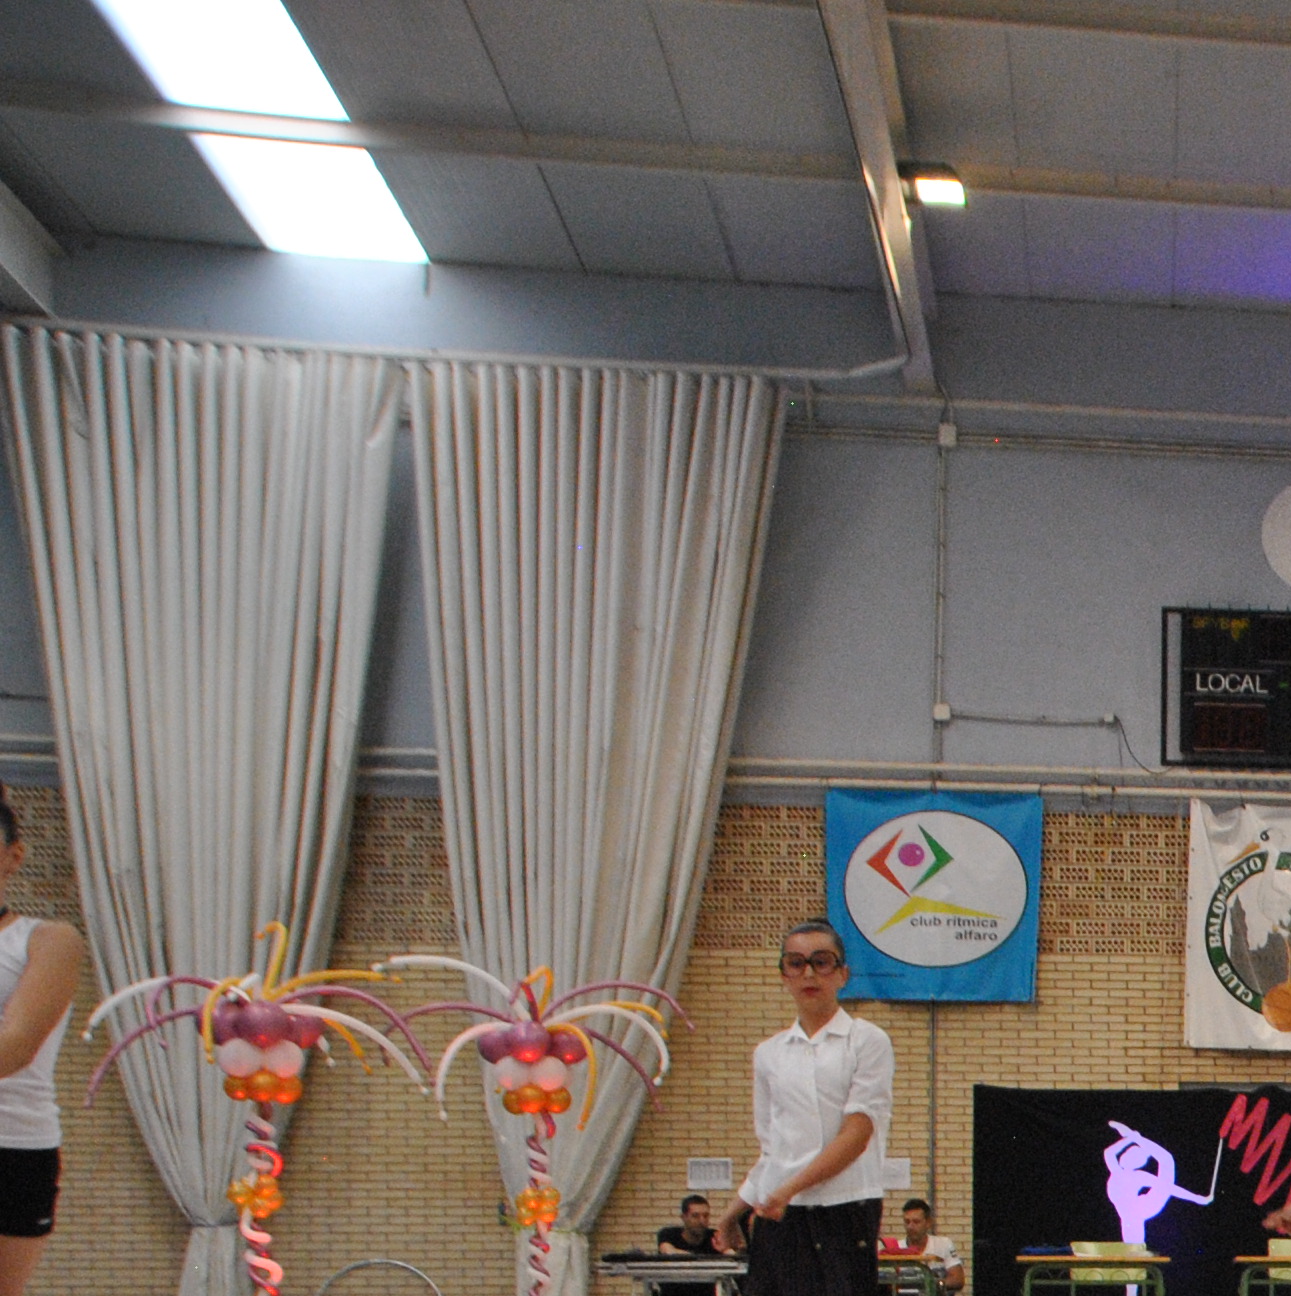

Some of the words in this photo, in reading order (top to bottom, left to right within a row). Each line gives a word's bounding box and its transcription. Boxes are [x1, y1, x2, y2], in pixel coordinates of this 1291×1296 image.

[1195, 673, 1268, 694] LOCAL
[910, 915, 941, 927] club
[955, 931, 997, 941] alfaro
[1218, 963, 1253, 1002] CLUB
